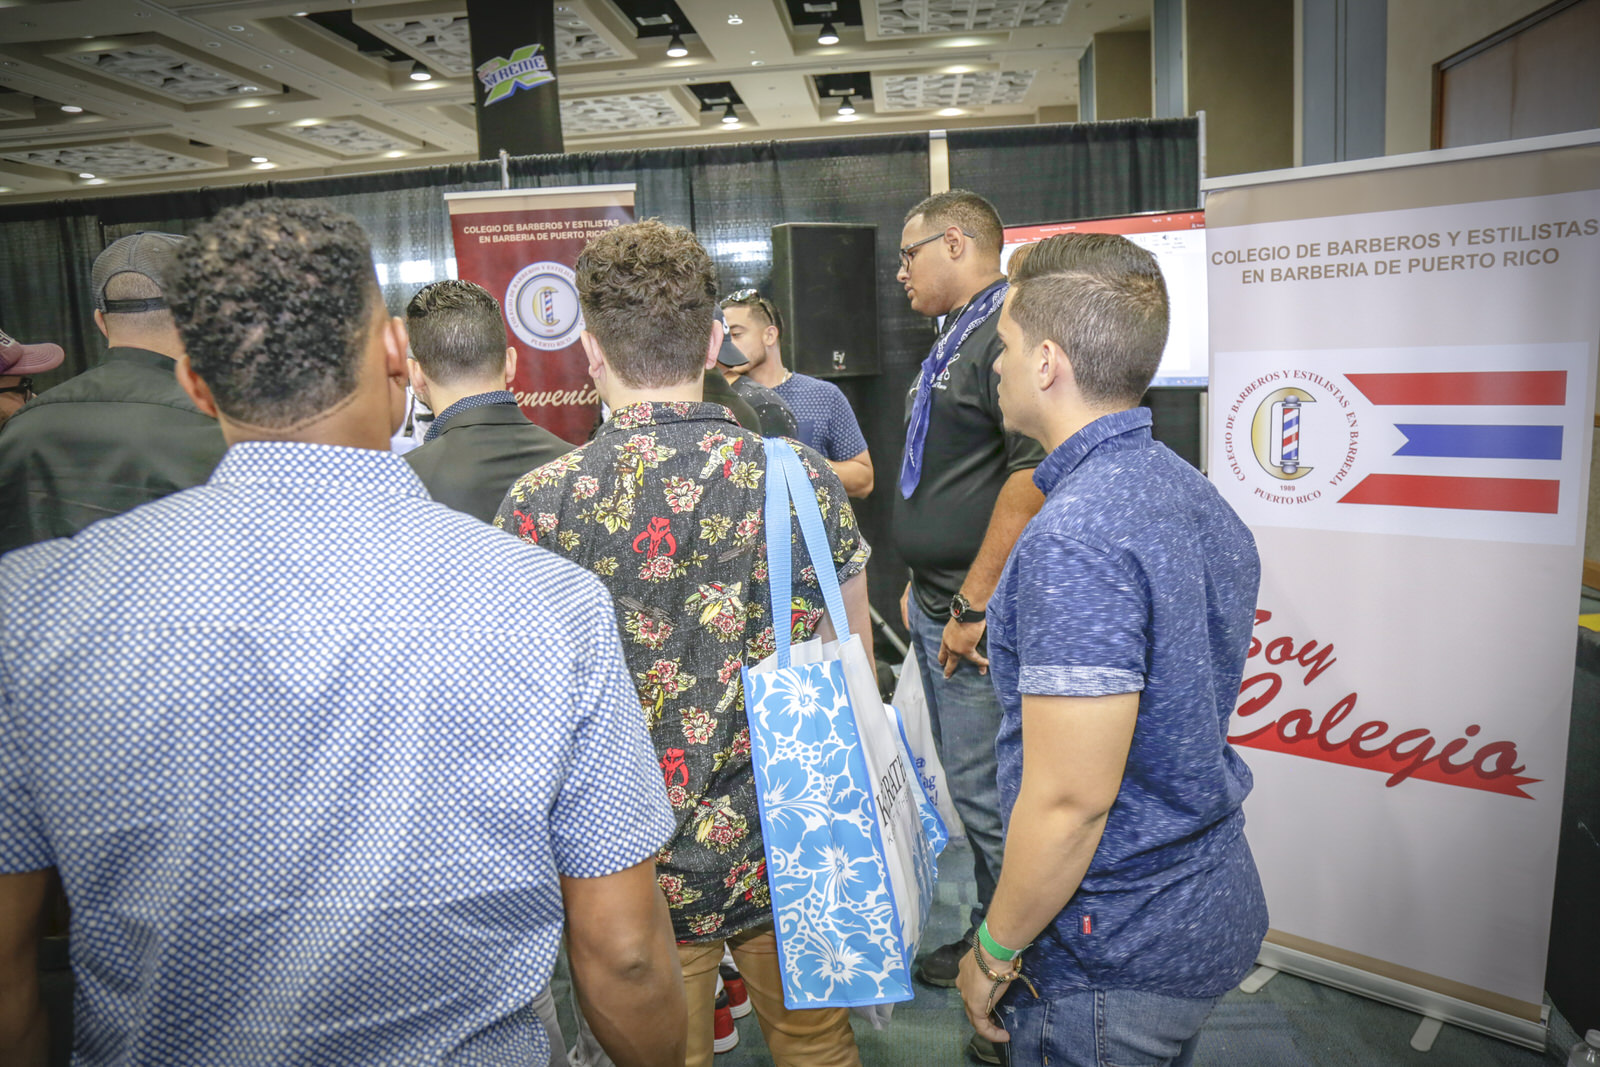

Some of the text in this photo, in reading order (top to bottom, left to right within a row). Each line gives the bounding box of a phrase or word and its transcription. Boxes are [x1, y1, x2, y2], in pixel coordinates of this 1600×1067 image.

[463, 219, 619, 234] COLEGIO DE BARBEROS Y ESTILISTAS
[479, 235, 491, 244] EN
[492, 232, 536, 243] BARBERIA
[537, 232, 549, 241] DE
[550, 230, 585, 240] PUERTO
[1211, 245, 1291, 266] COLEGIO
[1296, 243, 1321, 259] DE
[1327, 233, 1441, 256] BARBEROS
[1447, 231, 1461, 247] Y
[1467, 218, 1599, 246] ESTILISTAS
[1242, 247, 1560, 284] EN BARBERIA DE PUERTO RICO
[1225, 370, 1359, 487] COLEGIO DE BARBEROS Y ESTILISTAS EN BARBERIA
[1254, 487, 1322, 505] PUERTO RICO
[1226, 672, 1526, 788] Colegio
